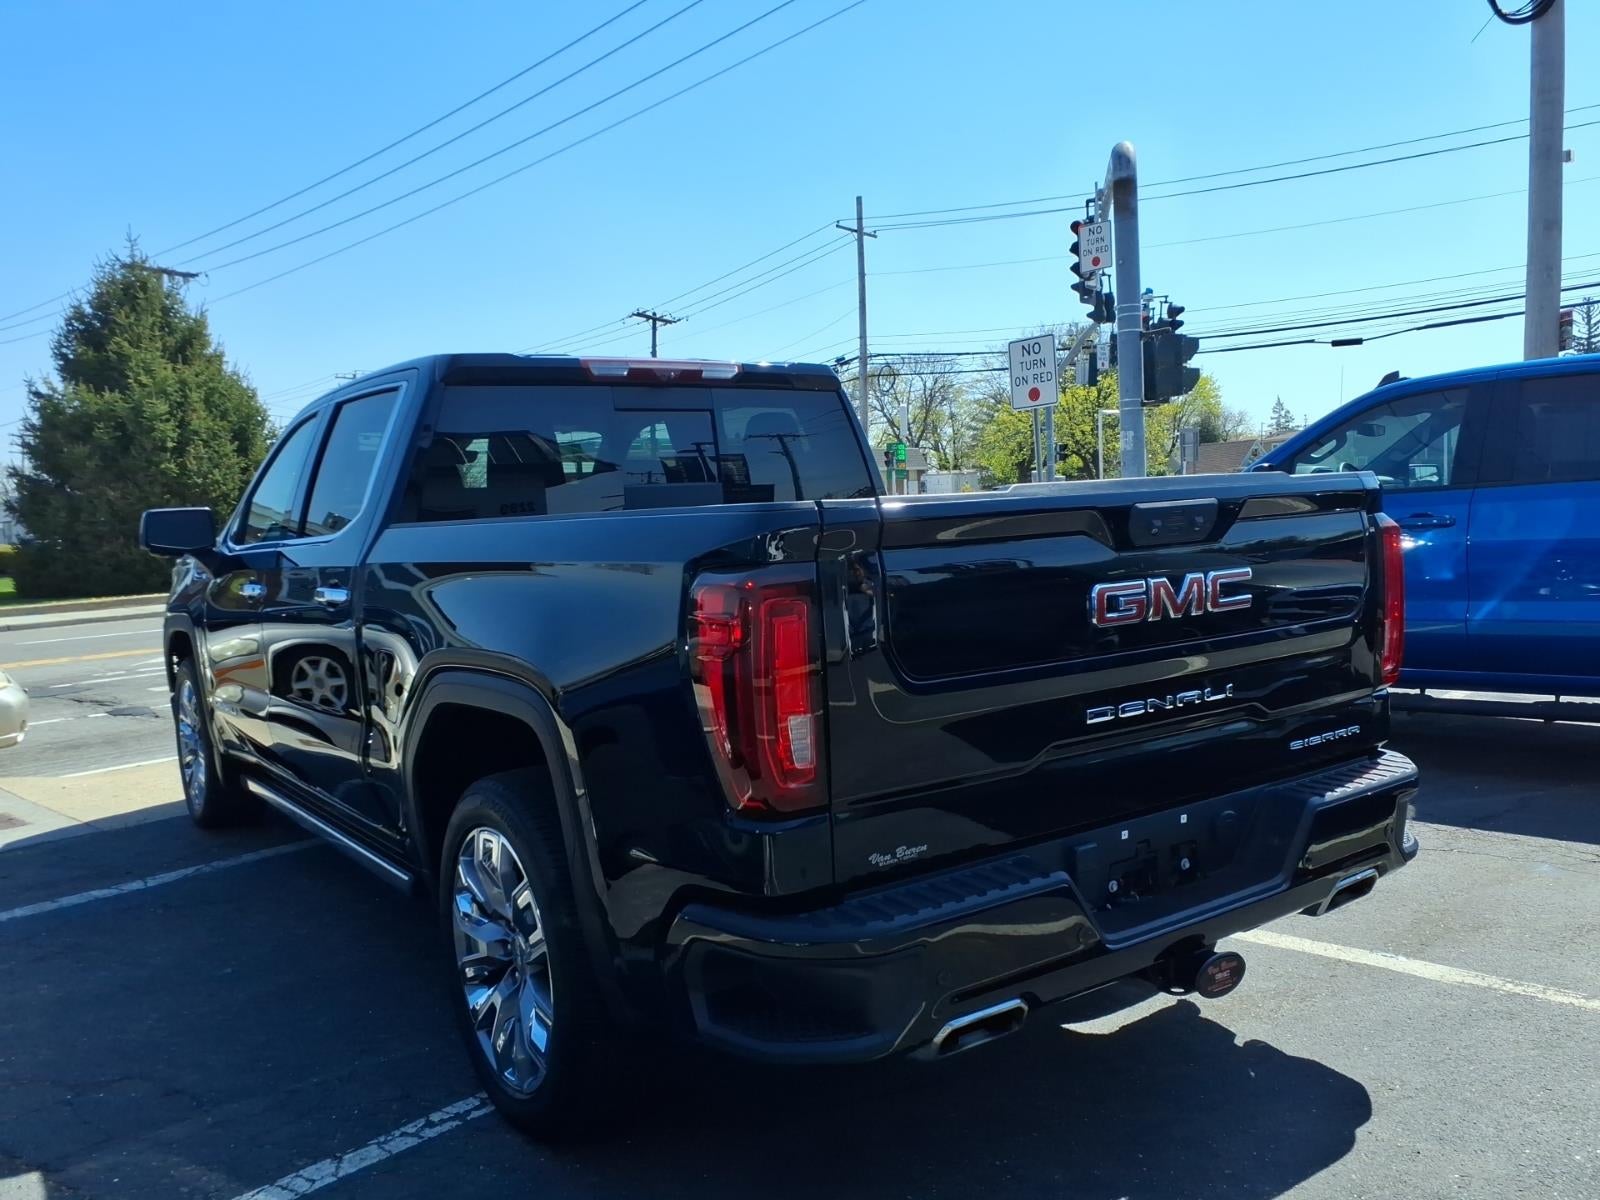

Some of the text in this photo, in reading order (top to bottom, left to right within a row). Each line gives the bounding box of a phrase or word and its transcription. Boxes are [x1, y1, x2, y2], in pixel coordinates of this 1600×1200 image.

[1088, 225, 1103, 236] NO
[1086, 235, 1105, 246] TURN
[1082, 244, 1109, 257] ON RED
[1021, 342, 1042, 357] NO
[1019, 357, 1047, 372] TURN
[1014, 371, 1053, 387] ON RED
[1091, 567, 1252, 628] GMC
[1086, 683, 1233, 724] DENALI
[1290, 725, 1360, 750] SIERRA
